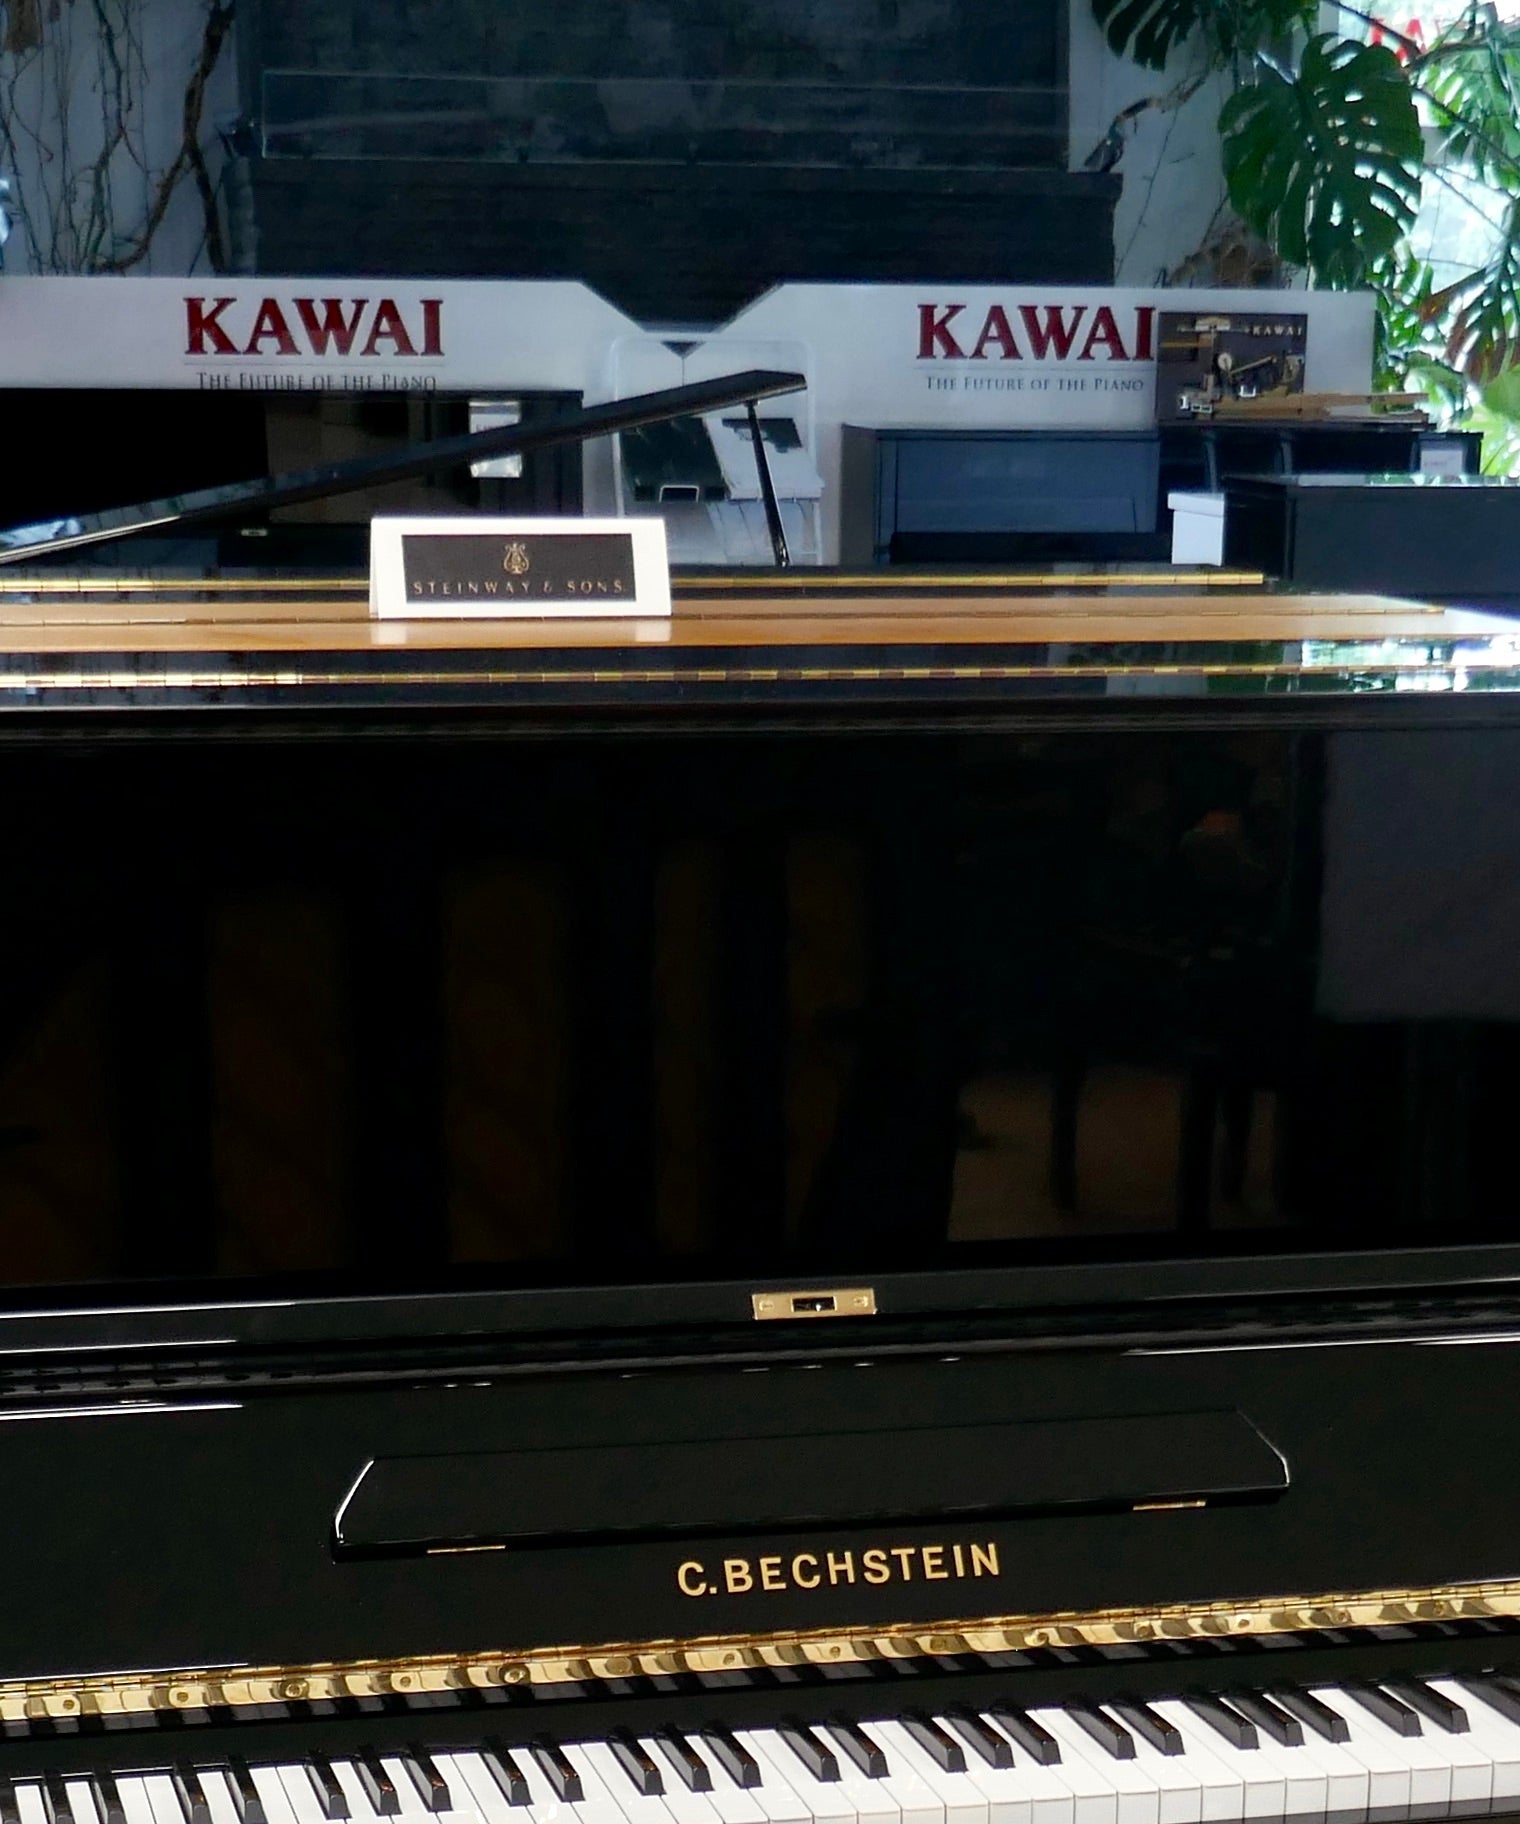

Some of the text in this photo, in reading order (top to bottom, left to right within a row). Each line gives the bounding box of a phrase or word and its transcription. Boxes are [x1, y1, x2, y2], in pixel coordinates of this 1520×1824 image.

[183, 297, 445, 356] KAWAI
[917, 304, 1156, 361] KAWAI
[1252, 325, 1303, 337] KAWAI
[196, 372, 231, 390] THE
[382, 374, 437, 390] PIANO
[926, 376, 1145, 391] THE FUTURE OF THE PIANO
[412, 581, 530, 595] STEINWAY
[567, 580, 623, 594] SONS
[677, 1543, 1000, 1597] C.BECHSTEIN
